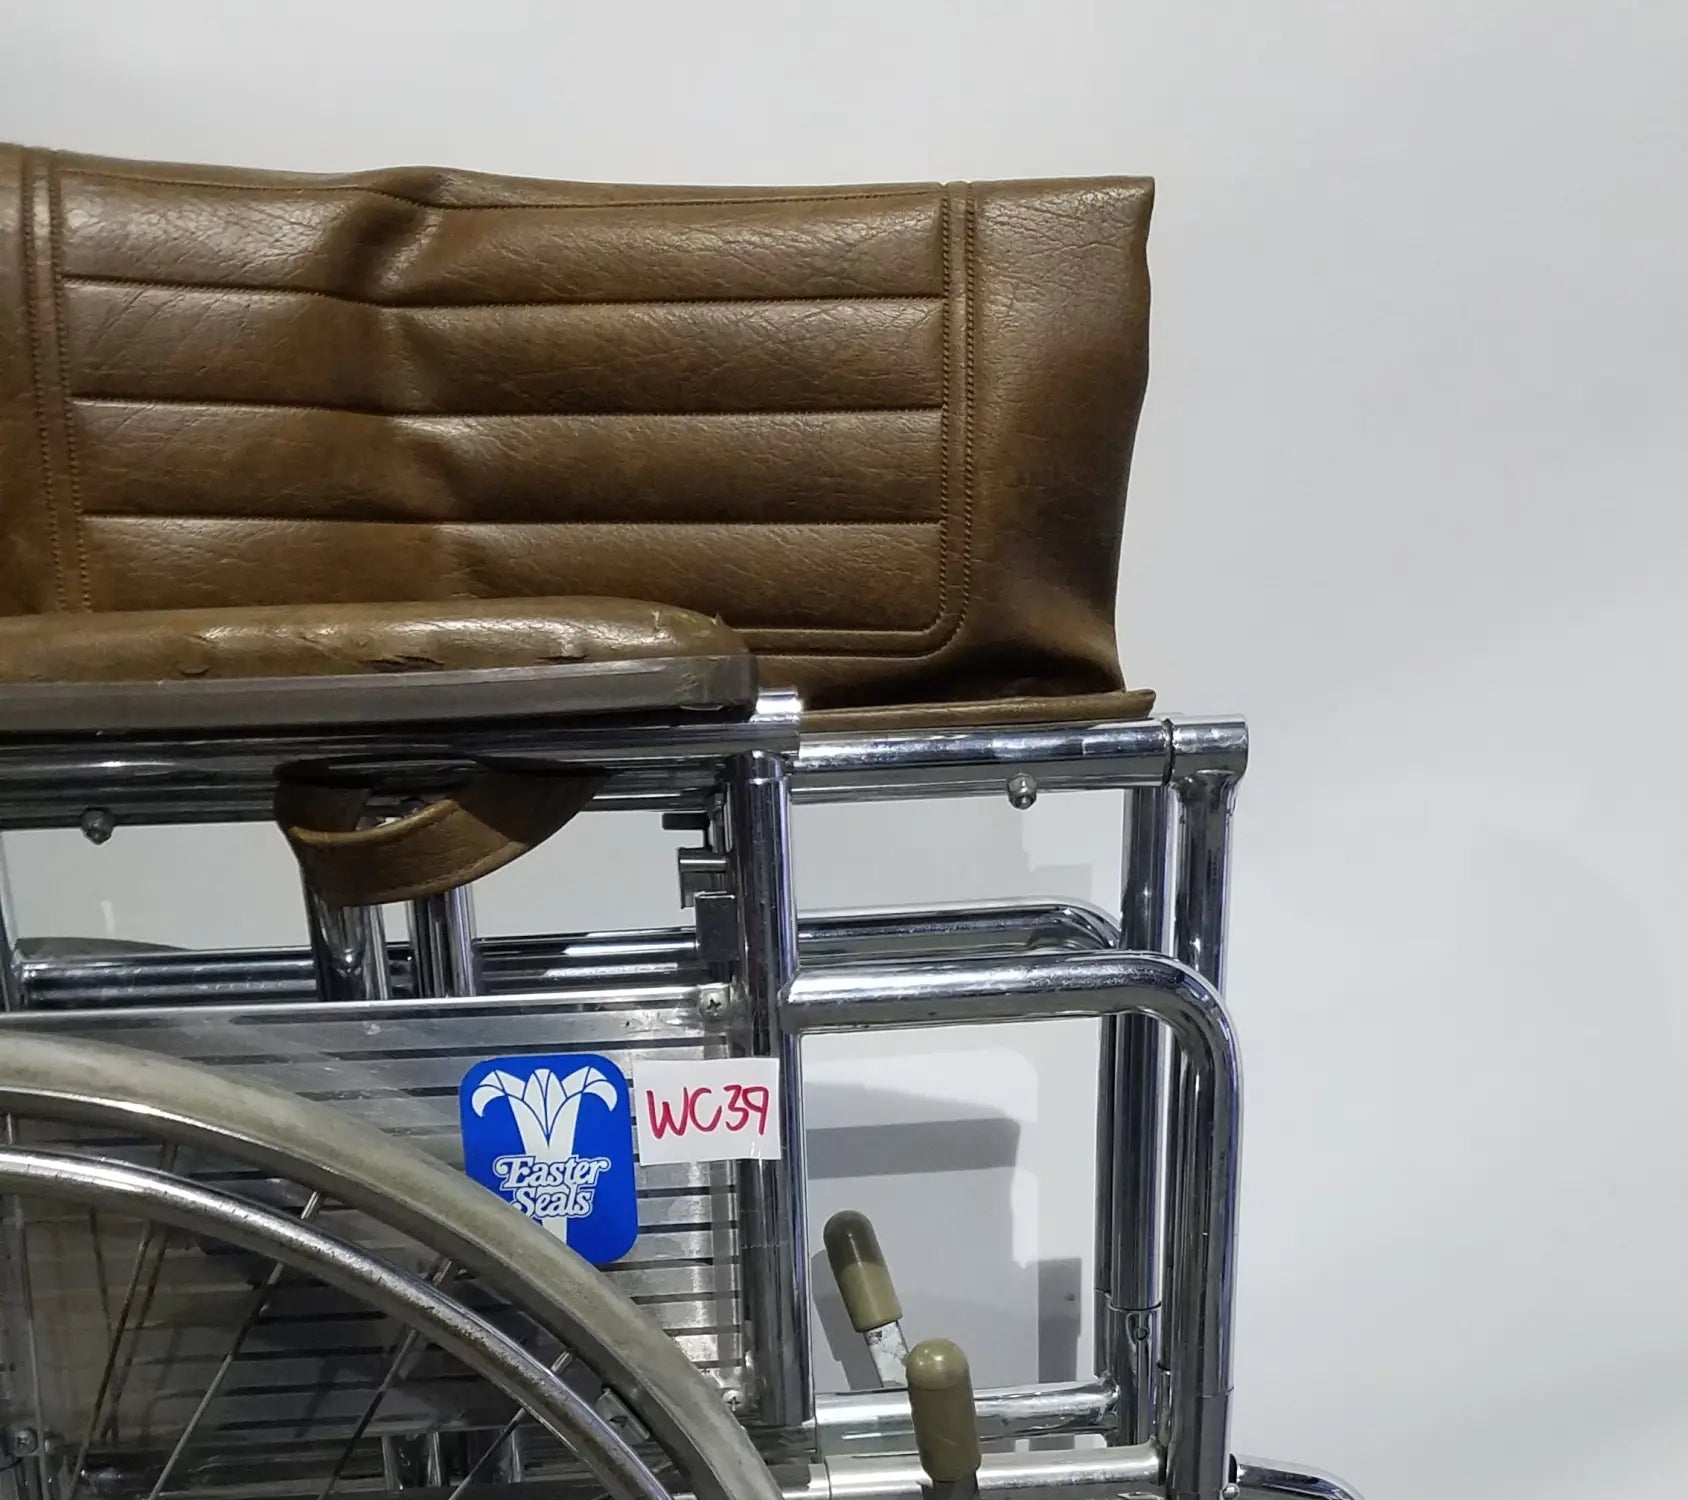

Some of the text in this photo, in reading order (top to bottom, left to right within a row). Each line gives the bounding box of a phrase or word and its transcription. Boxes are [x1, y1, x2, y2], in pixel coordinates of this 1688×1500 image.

[646, 1084, 769, 1139] WC39
[494, 1156, 610, 1188] Easter
[511, 1184, 593, 1217] Seals
